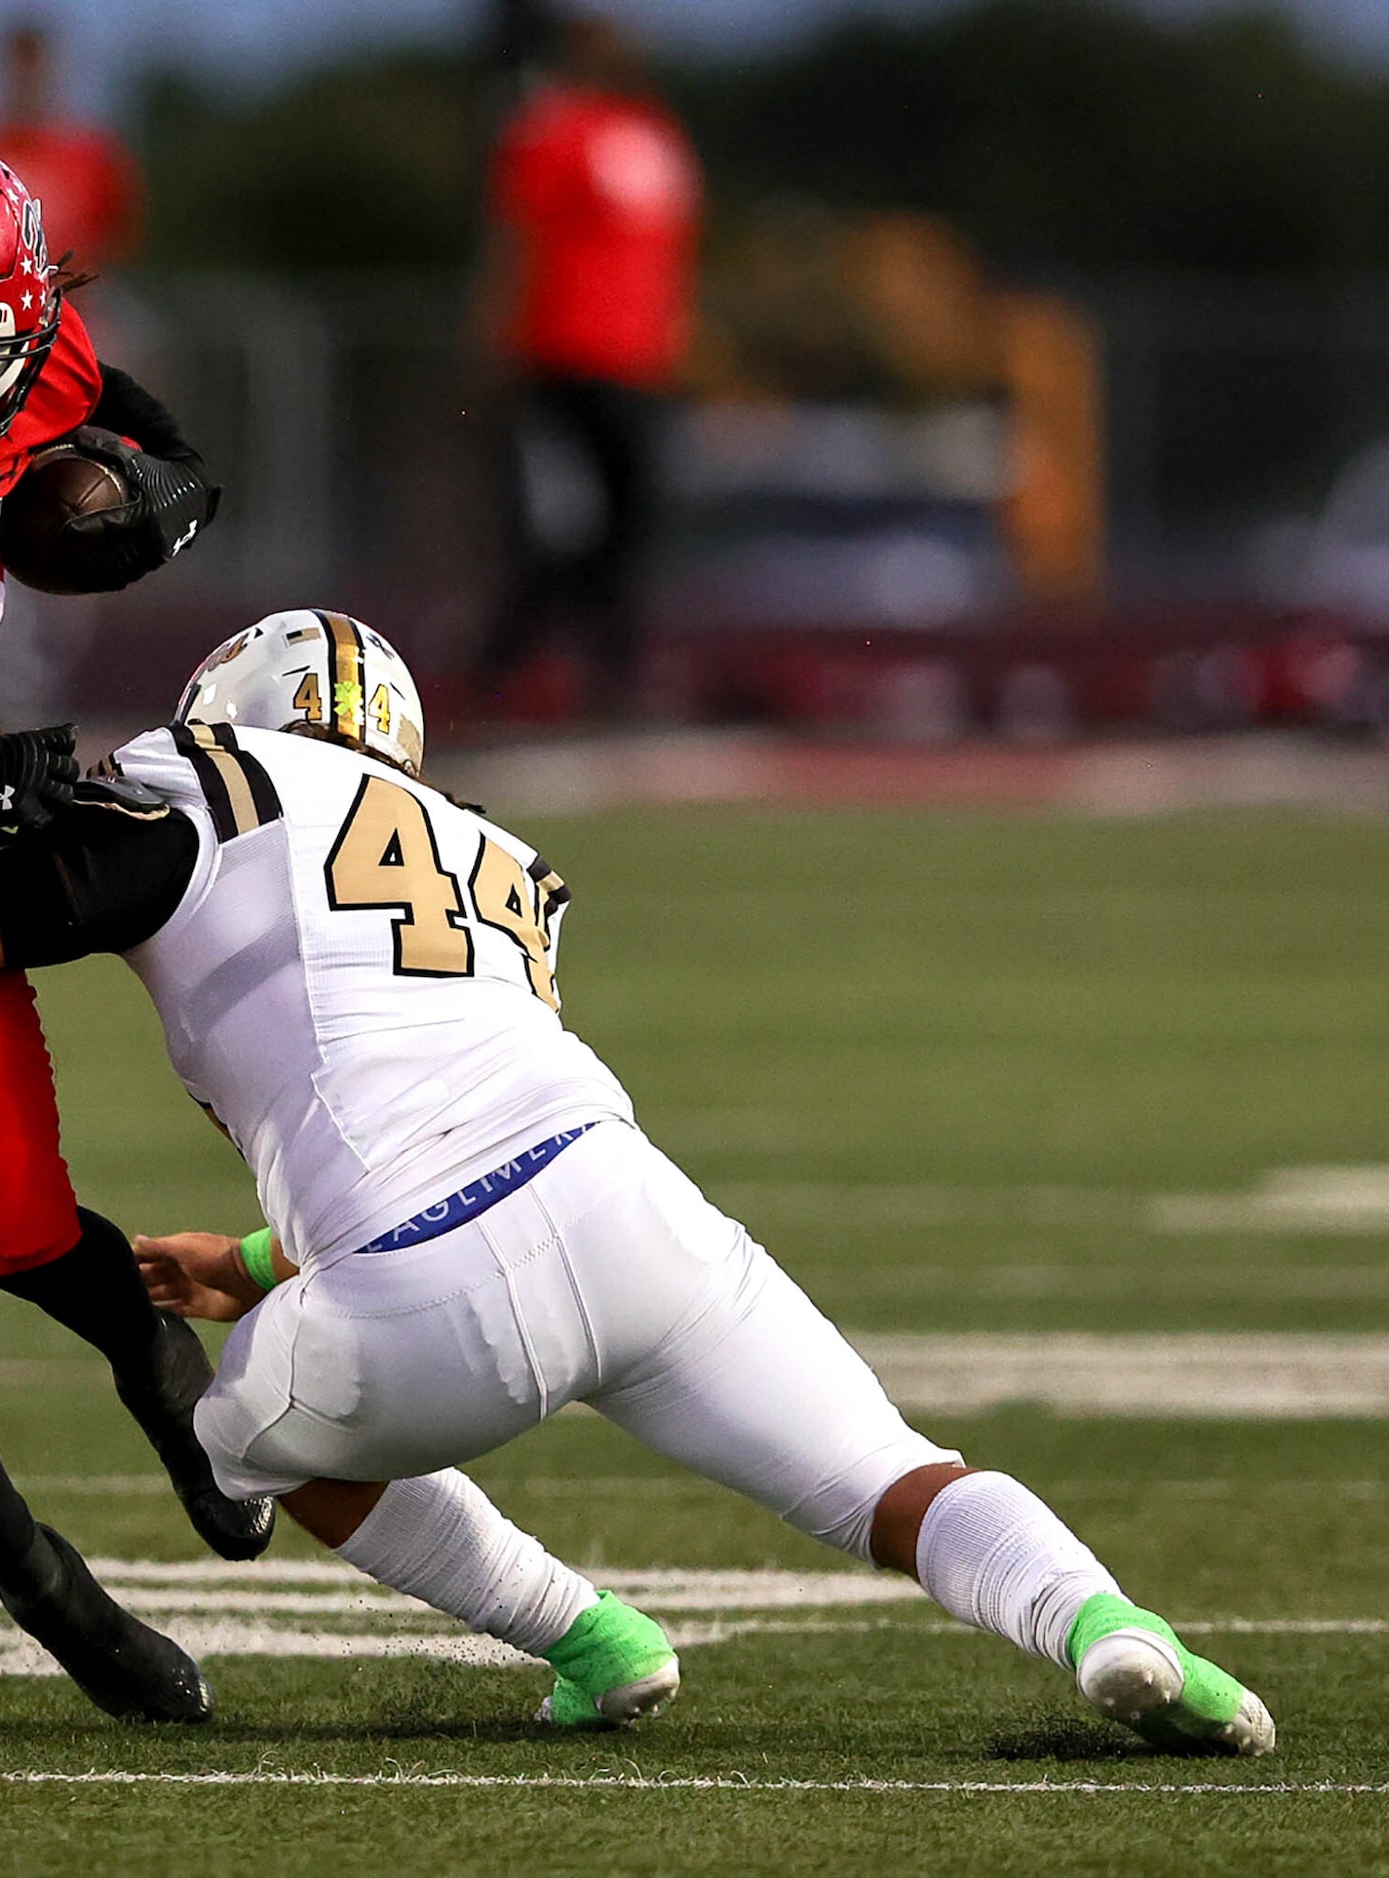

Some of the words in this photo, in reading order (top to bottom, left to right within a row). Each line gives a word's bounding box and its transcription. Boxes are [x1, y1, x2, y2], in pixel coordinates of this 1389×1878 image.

[293, 673, 322, 721] 4
[368, 683, 390, 733] 4
[323, 773, 562, 1014] 44
